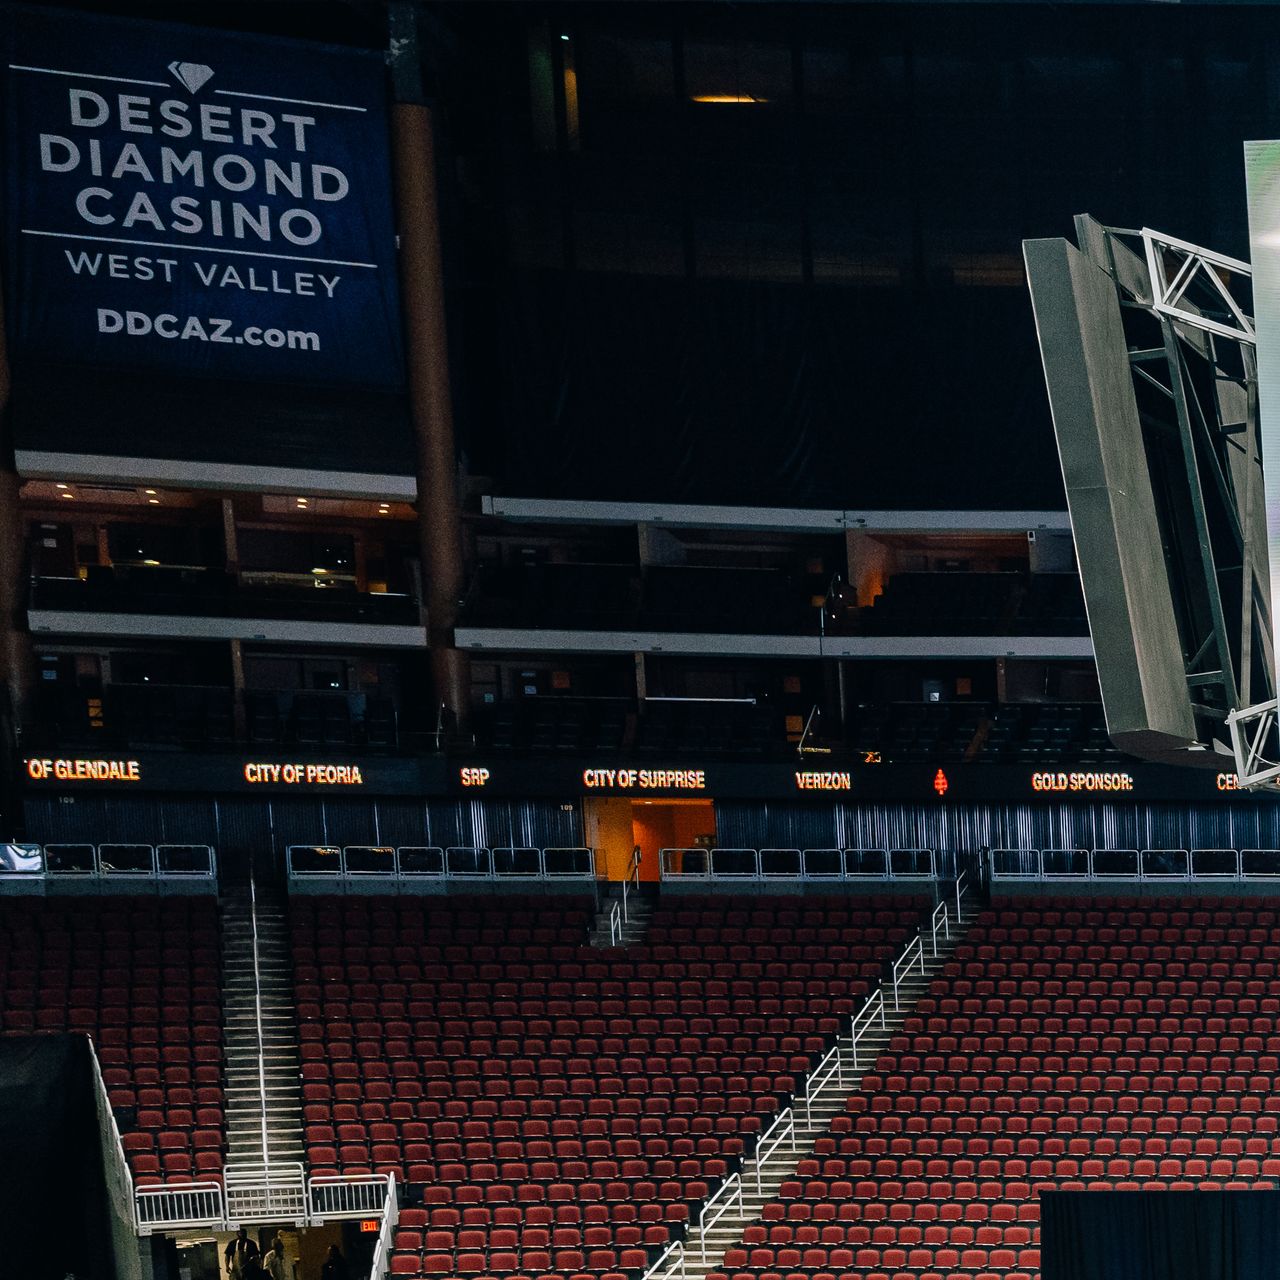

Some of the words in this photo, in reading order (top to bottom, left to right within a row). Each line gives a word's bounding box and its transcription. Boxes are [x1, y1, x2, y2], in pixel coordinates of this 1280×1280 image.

[69, 88, 316, 152] DESERT
[40, 133, 349, 202] DIAMOND
[75, 186, 322, 246] CASINO
[64, 250, 179, 283] WEST
[194, 262, 341, 298] VALLEY
[97, 308, 320, 351] DDCAZ.com
[29, 759, 52, 779] OF
[55, 760, 141, 780] GLENDALE
[244, 762, 281, 783] CITY
[282, 764, 305, 783] OF
[306, 764, 363, 784] PEORIA
[461, 767, 490, 786] SRP
[583, 768, 616, 787] CITY
[618, 770, 638, 787] OF
[639, 770, 705, 789] SURPRISE
[796, 771, 851, 790] VERIZON
[1032, 772, 1069, 791] GOLD
[1070, 772, 1133, 791] SPONSOR:
